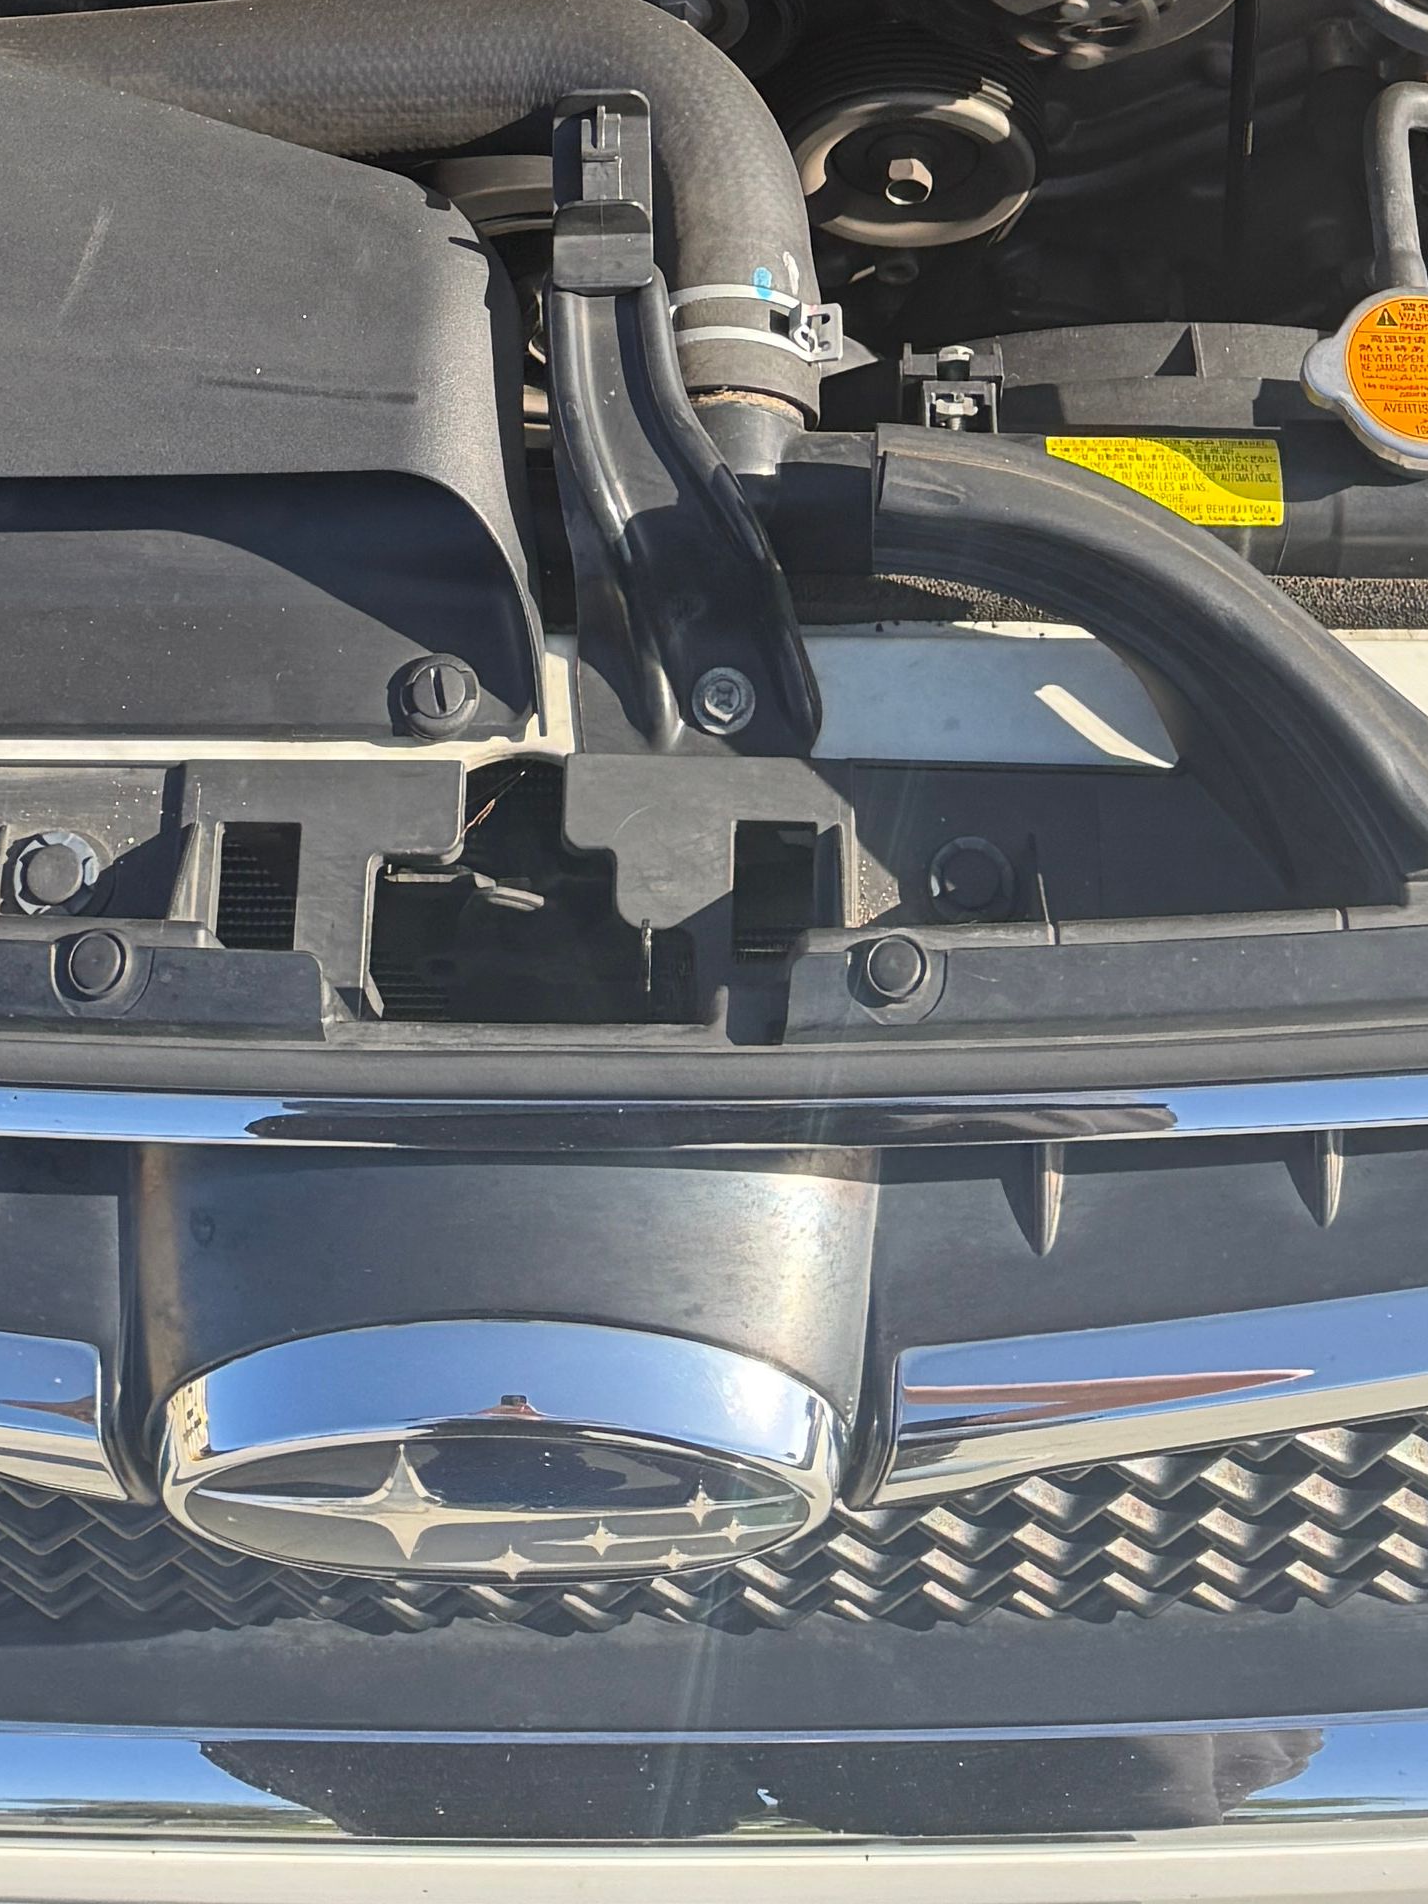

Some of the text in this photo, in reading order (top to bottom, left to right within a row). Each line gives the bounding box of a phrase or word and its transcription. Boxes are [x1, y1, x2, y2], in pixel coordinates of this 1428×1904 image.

[1359, 353, 1393, 363] NEVER
[1396, 354, 1424, 364] OPEN
[1138, 482, 1155, 491] PAS
[1159, 483, 1175, 492] LES
